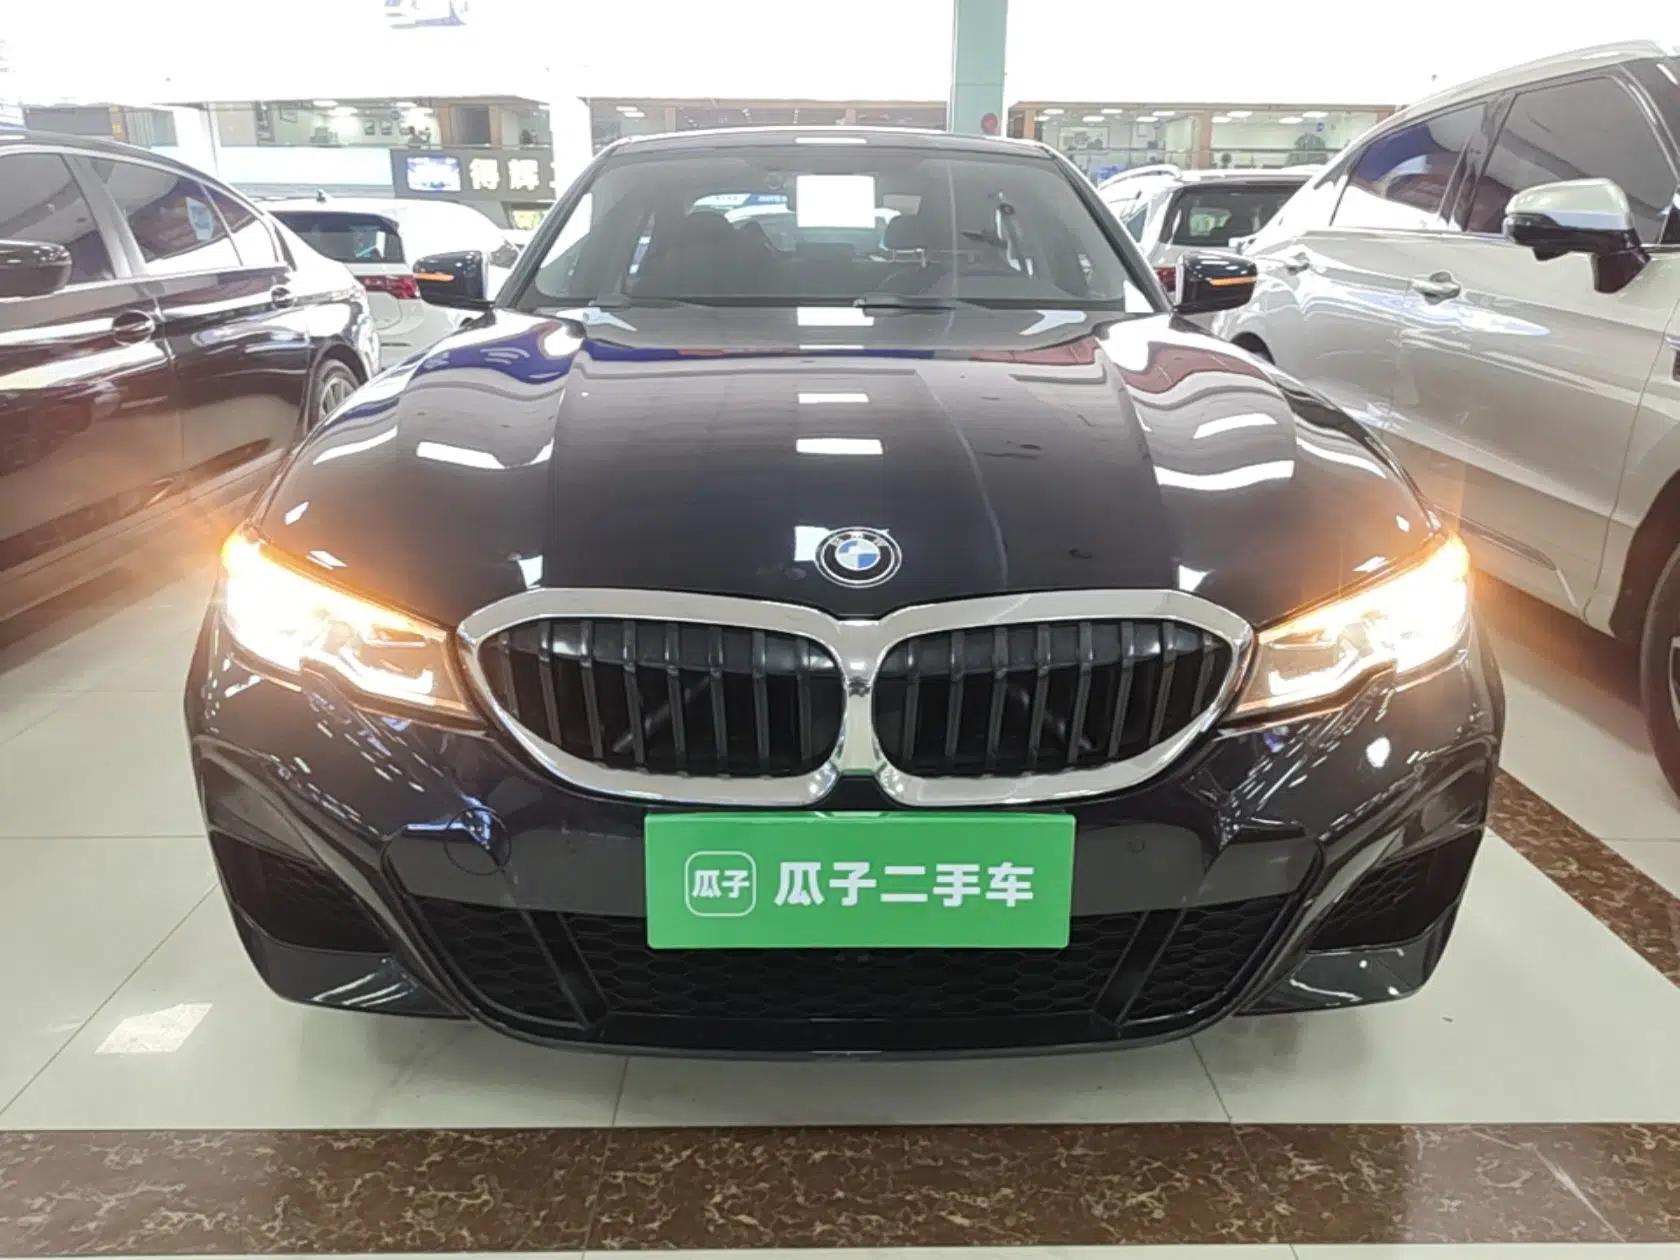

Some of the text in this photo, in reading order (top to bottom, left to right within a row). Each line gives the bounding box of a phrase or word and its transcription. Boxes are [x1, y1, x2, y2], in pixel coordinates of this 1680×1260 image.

[691, 869, 751, 899] 瓜子
[773, 861, 1036, 908] 瓜子二手车
